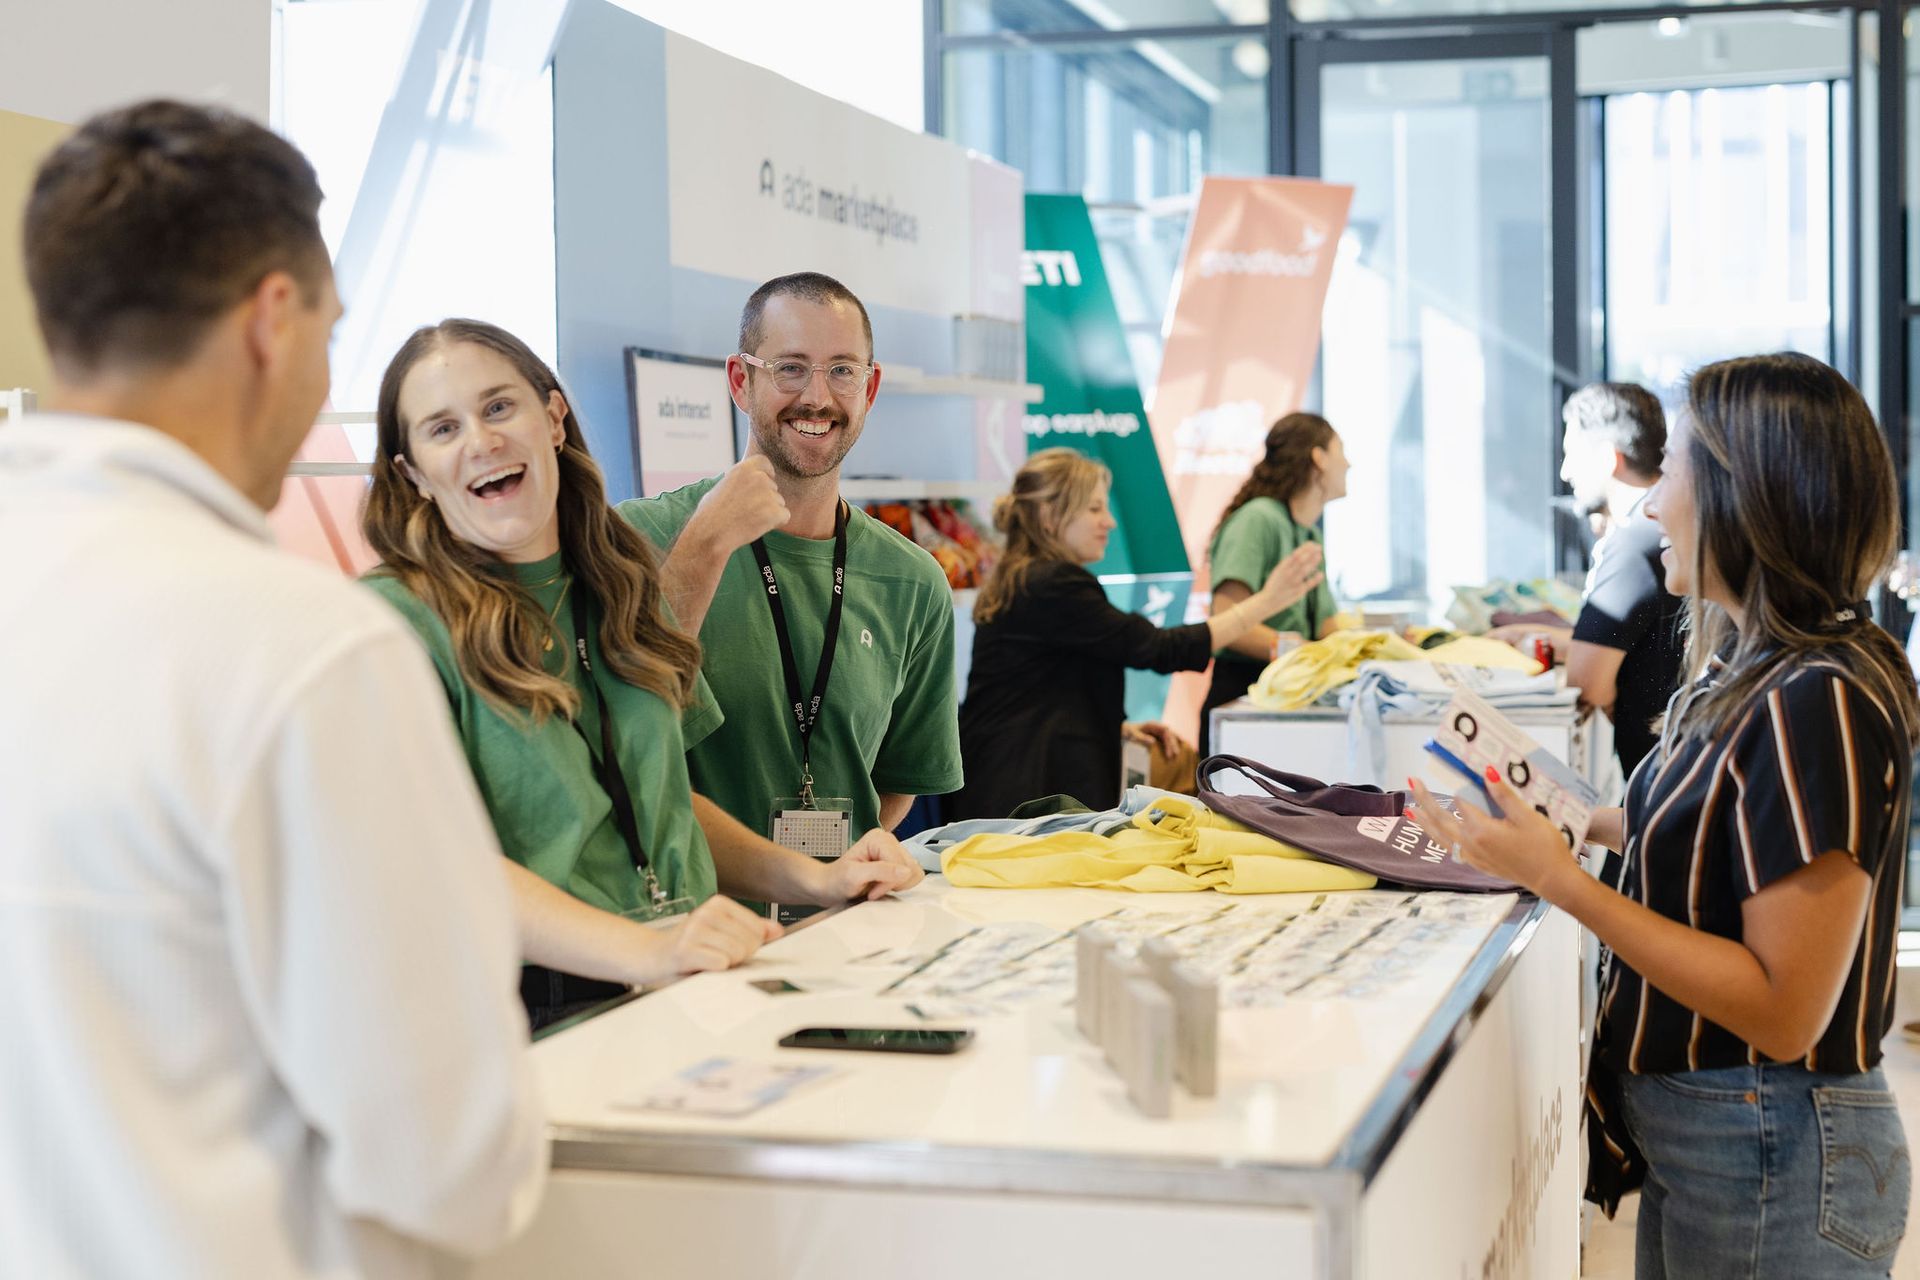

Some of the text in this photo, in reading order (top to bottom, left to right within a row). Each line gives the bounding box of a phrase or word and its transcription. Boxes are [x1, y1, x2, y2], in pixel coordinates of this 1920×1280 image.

[782, 166, 815, 217] ada
[818, 183, 919, 247] marketplace
[1051, 408, 1141, 438] earplugs
[763, 565, 775, 583] ada
[835, 567, 843, 584] ada
[794, 702, 804, 721] ada
[811, 695, 821, 714] ada
